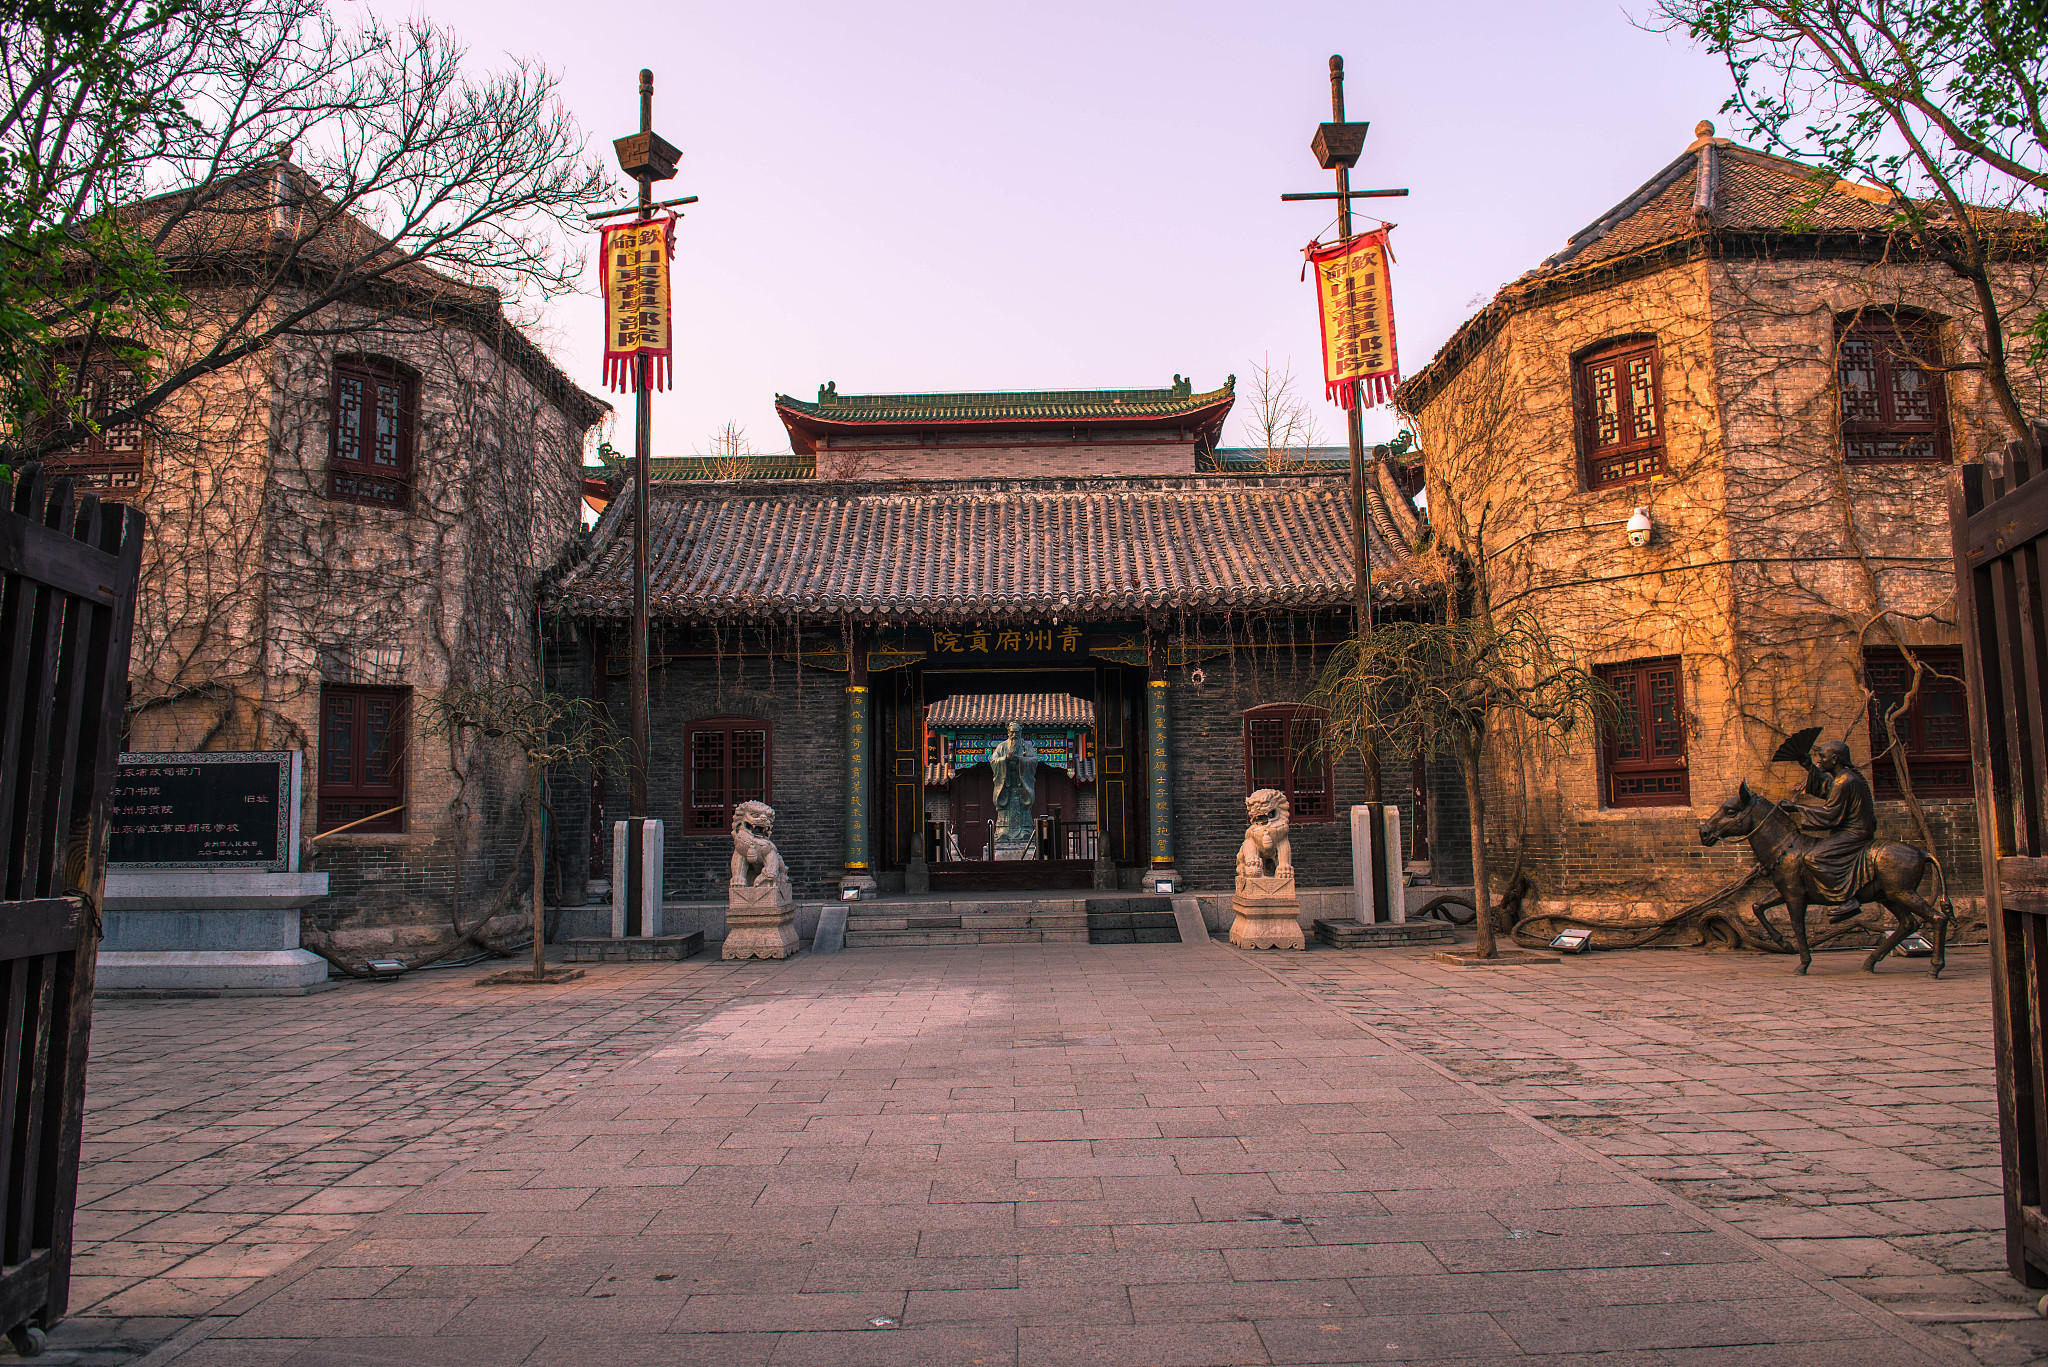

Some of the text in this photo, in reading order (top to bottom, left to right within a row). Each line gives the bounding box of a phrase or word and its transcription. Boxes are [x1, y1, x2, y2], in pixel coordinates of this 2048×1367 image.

[613, 229, 662, 249] 欽命
[1326, 252, 1378, 281] 欽命
[933, 625, 1083, 653] 青州府貢院
[244, 794, 269, 803] 旧址
